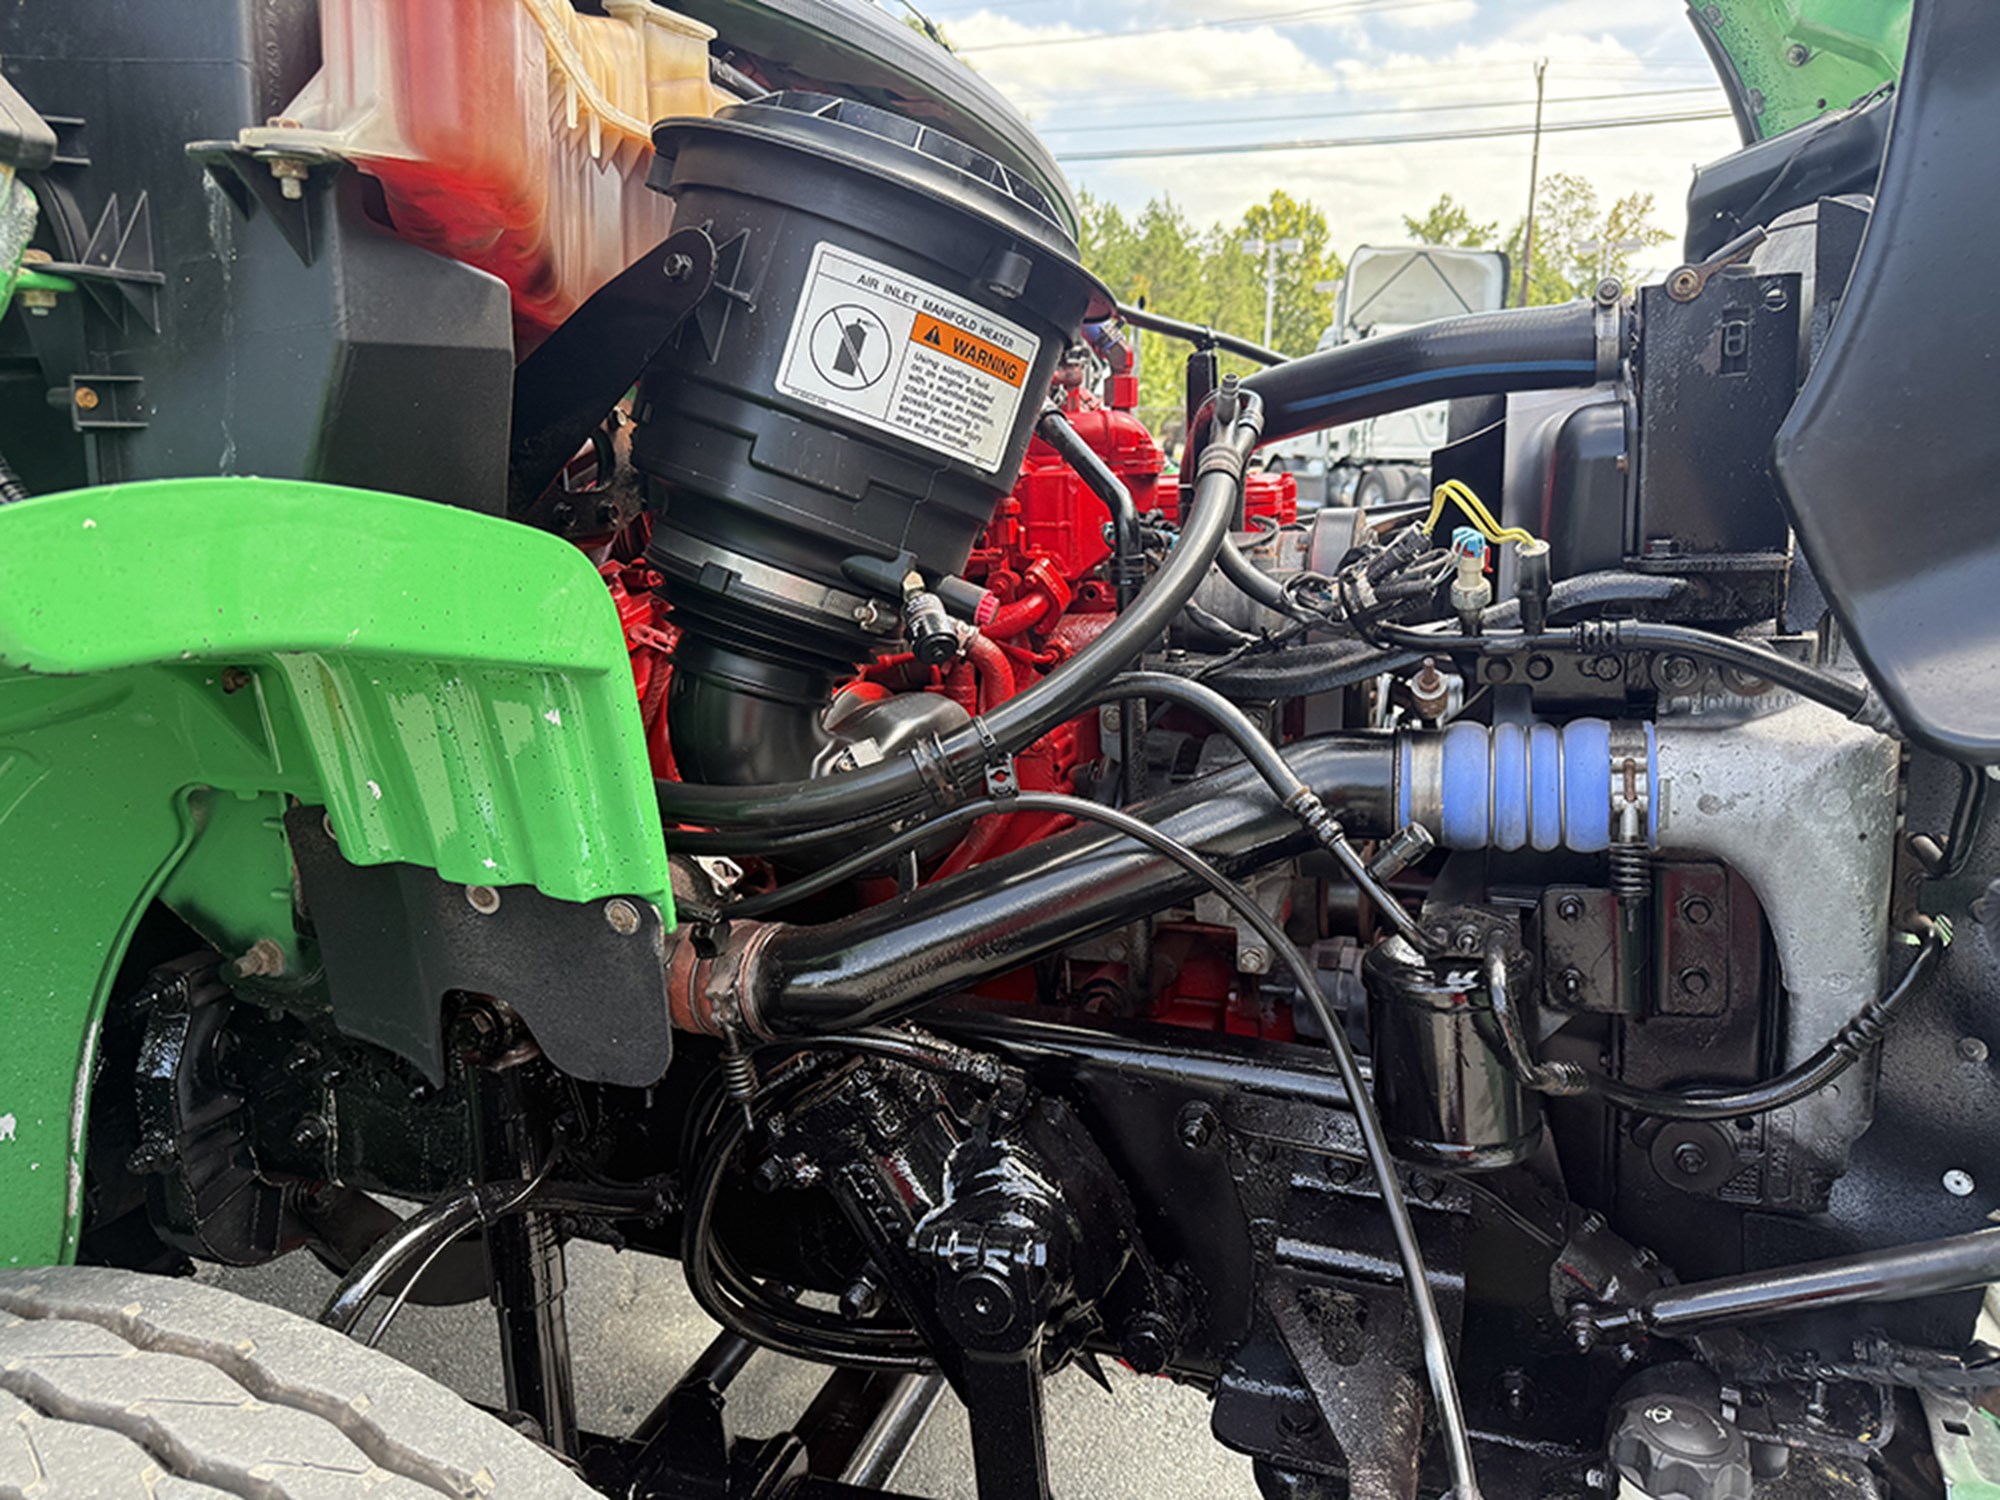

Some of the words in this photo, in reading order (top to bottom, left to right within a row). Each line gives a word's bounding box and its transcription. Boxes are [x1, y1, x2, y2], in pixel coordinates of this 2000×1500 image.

[857, 274, 879, 290] AIR
[883, 284, 918, 306] INLET
[921, 299, 978, 331] MANIFOLD
[979, 325, 1015, 349] HEATER
[952, 337, 1019, 381] WARNING
